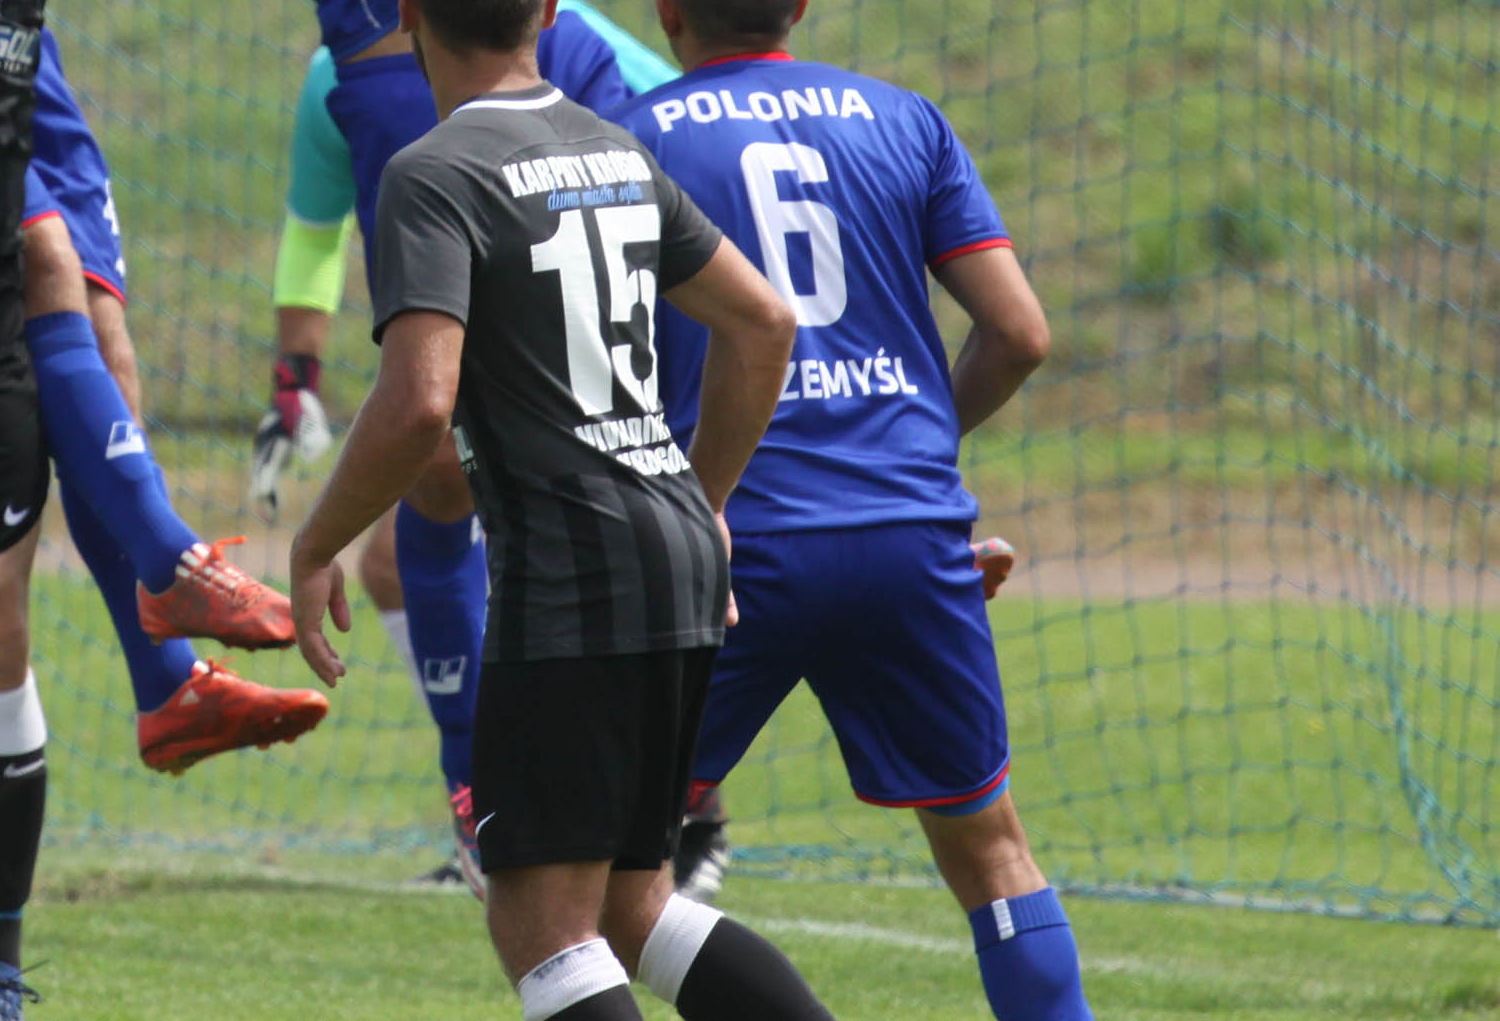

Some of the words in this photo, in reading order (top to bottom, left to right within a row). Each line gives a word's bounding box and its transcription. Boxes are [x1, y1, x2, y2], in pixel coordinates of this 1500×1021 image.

[652, 87, 875, 133] POLONIA
[741, 142, 848, 327] 6
[530, 204, 662, 416] 15
[779, 346, 918, 402] ZEMYŚL
